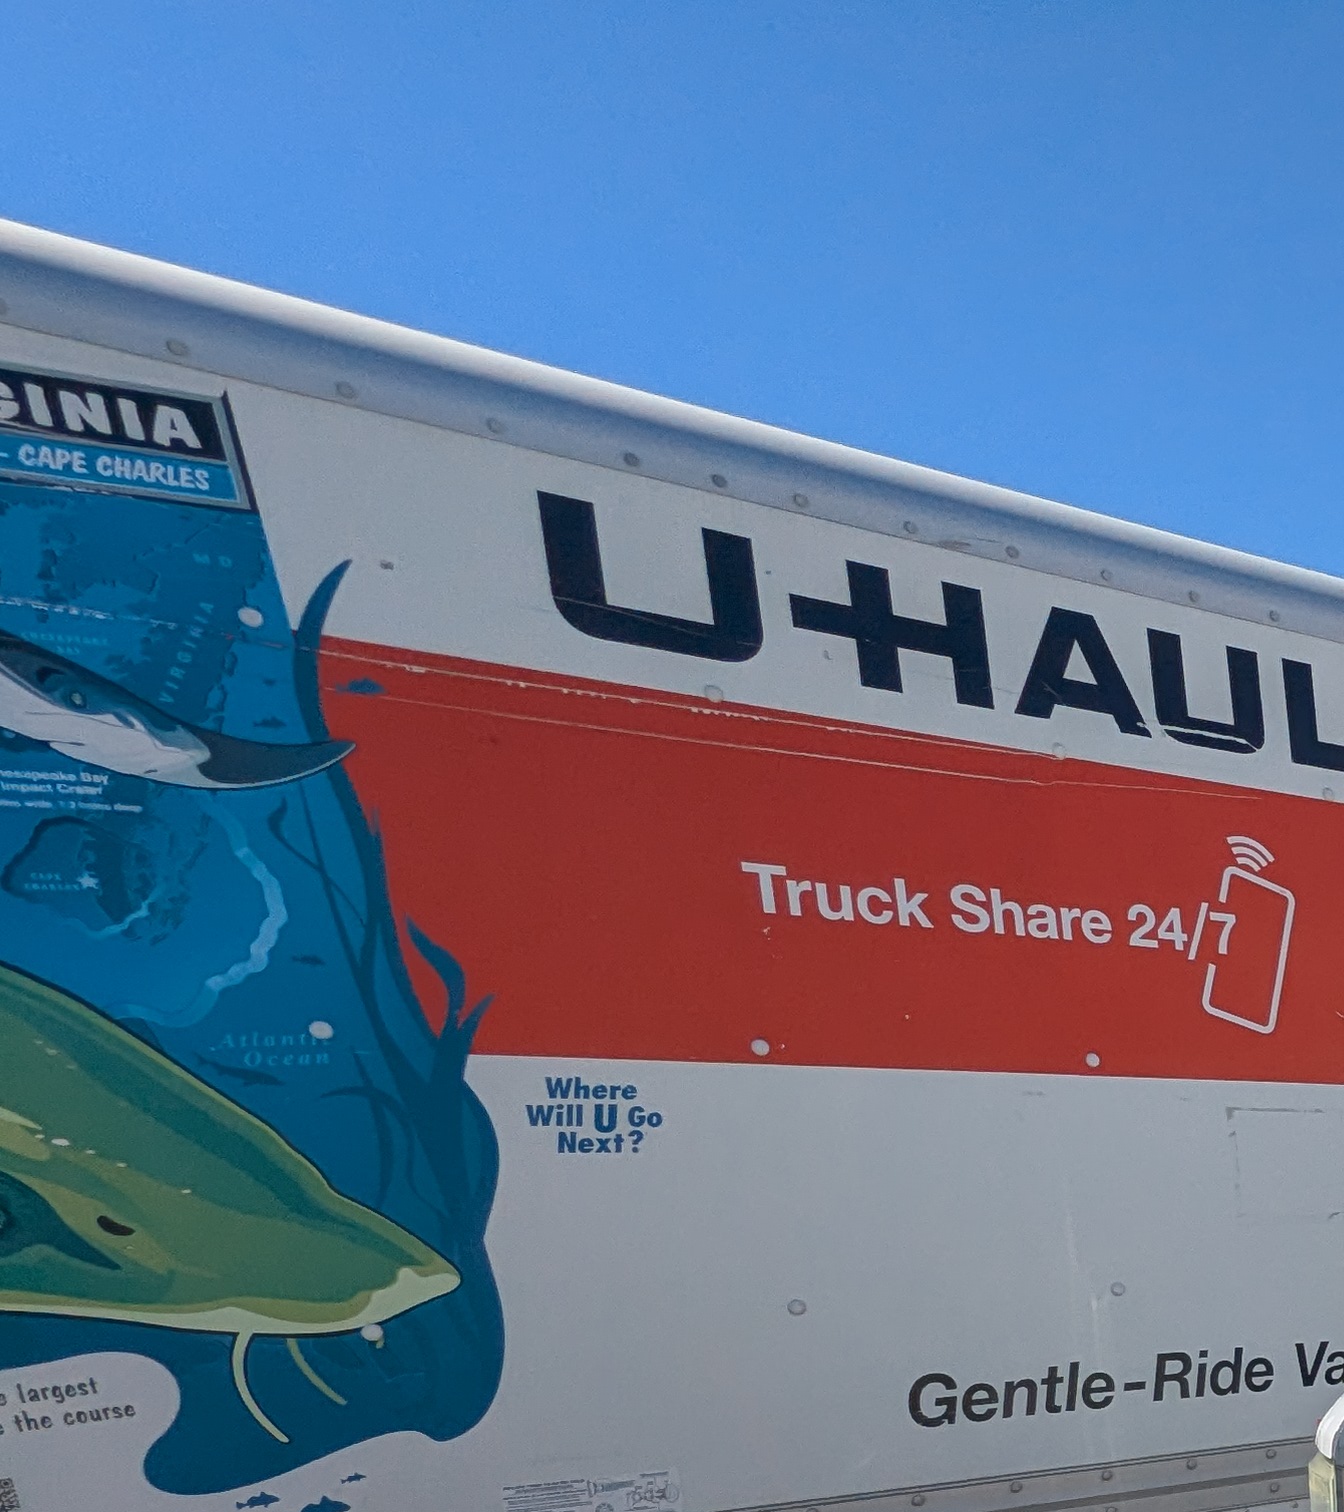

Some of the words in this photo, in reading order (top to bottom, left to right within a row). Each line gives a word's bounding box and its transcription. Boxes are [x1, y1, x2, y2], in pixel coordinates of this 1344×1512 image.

[18, 443, 89, 474] CAPE
[95, 454, 210, 491] CHARLES
[740, 860, 934, 930] Truck
[950, 882, 1112, 943] Share
[1126, 901, 1238, 961] 24/7
[243, 1050, 330, 1067] Ocean
[545, 1076, 639, 1101] Where
[525, 1104, 584, 1127] Will
[594, 1103, 619, 1134] U
[627, 1105, 664, 1128] Go
[557, 1129, 645, 1154] Next?
[16, 1377, 98, 1404] largest
[908, 1347, 1275, 1429] Gentle-Ride
[14, 1410, 53, 1432] the
[63, 1404, 136, 1426] course
